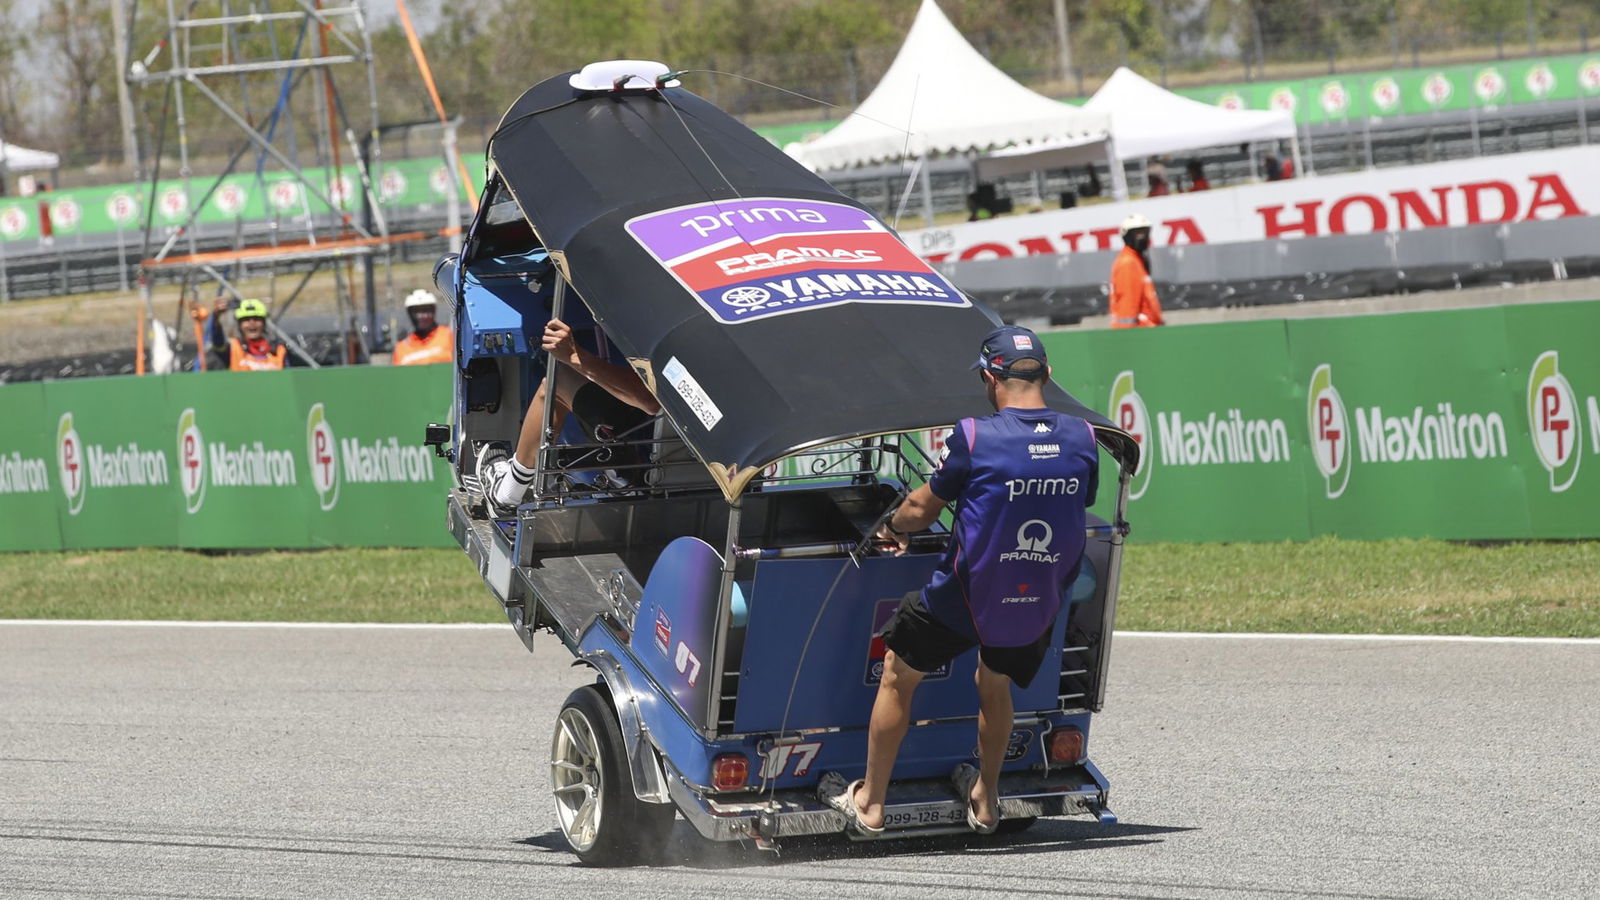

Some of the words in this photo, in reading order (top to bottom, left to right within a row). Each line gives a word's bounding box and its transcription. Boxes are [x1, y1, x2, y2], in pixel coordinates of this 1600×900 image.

[1256, 172, 1588, 239] HONDA
[680, 207, 828, 238] prima
[715, 247, 883, 271] PRAMAC
[765, 273, 944, 299] YAMAHA
[734, 291, 847, 316] FACTORY
[1157, 408, 1290, 466] Maxnitron
[1355, 402, 1507, 463] Maxnitron
[341, 437, 435, 483] Maxnitron
[1036, 444, 1060, 453] YAMAHA
[86, 442, 169, 487] Maxnitron
[209, 441, 297, 487] Maxnitron
[1005, 478, 1079, 501] prima
[999, 552, 1060, 563] PRAMAC
[884, 810, 967, 825] 099-128-43
